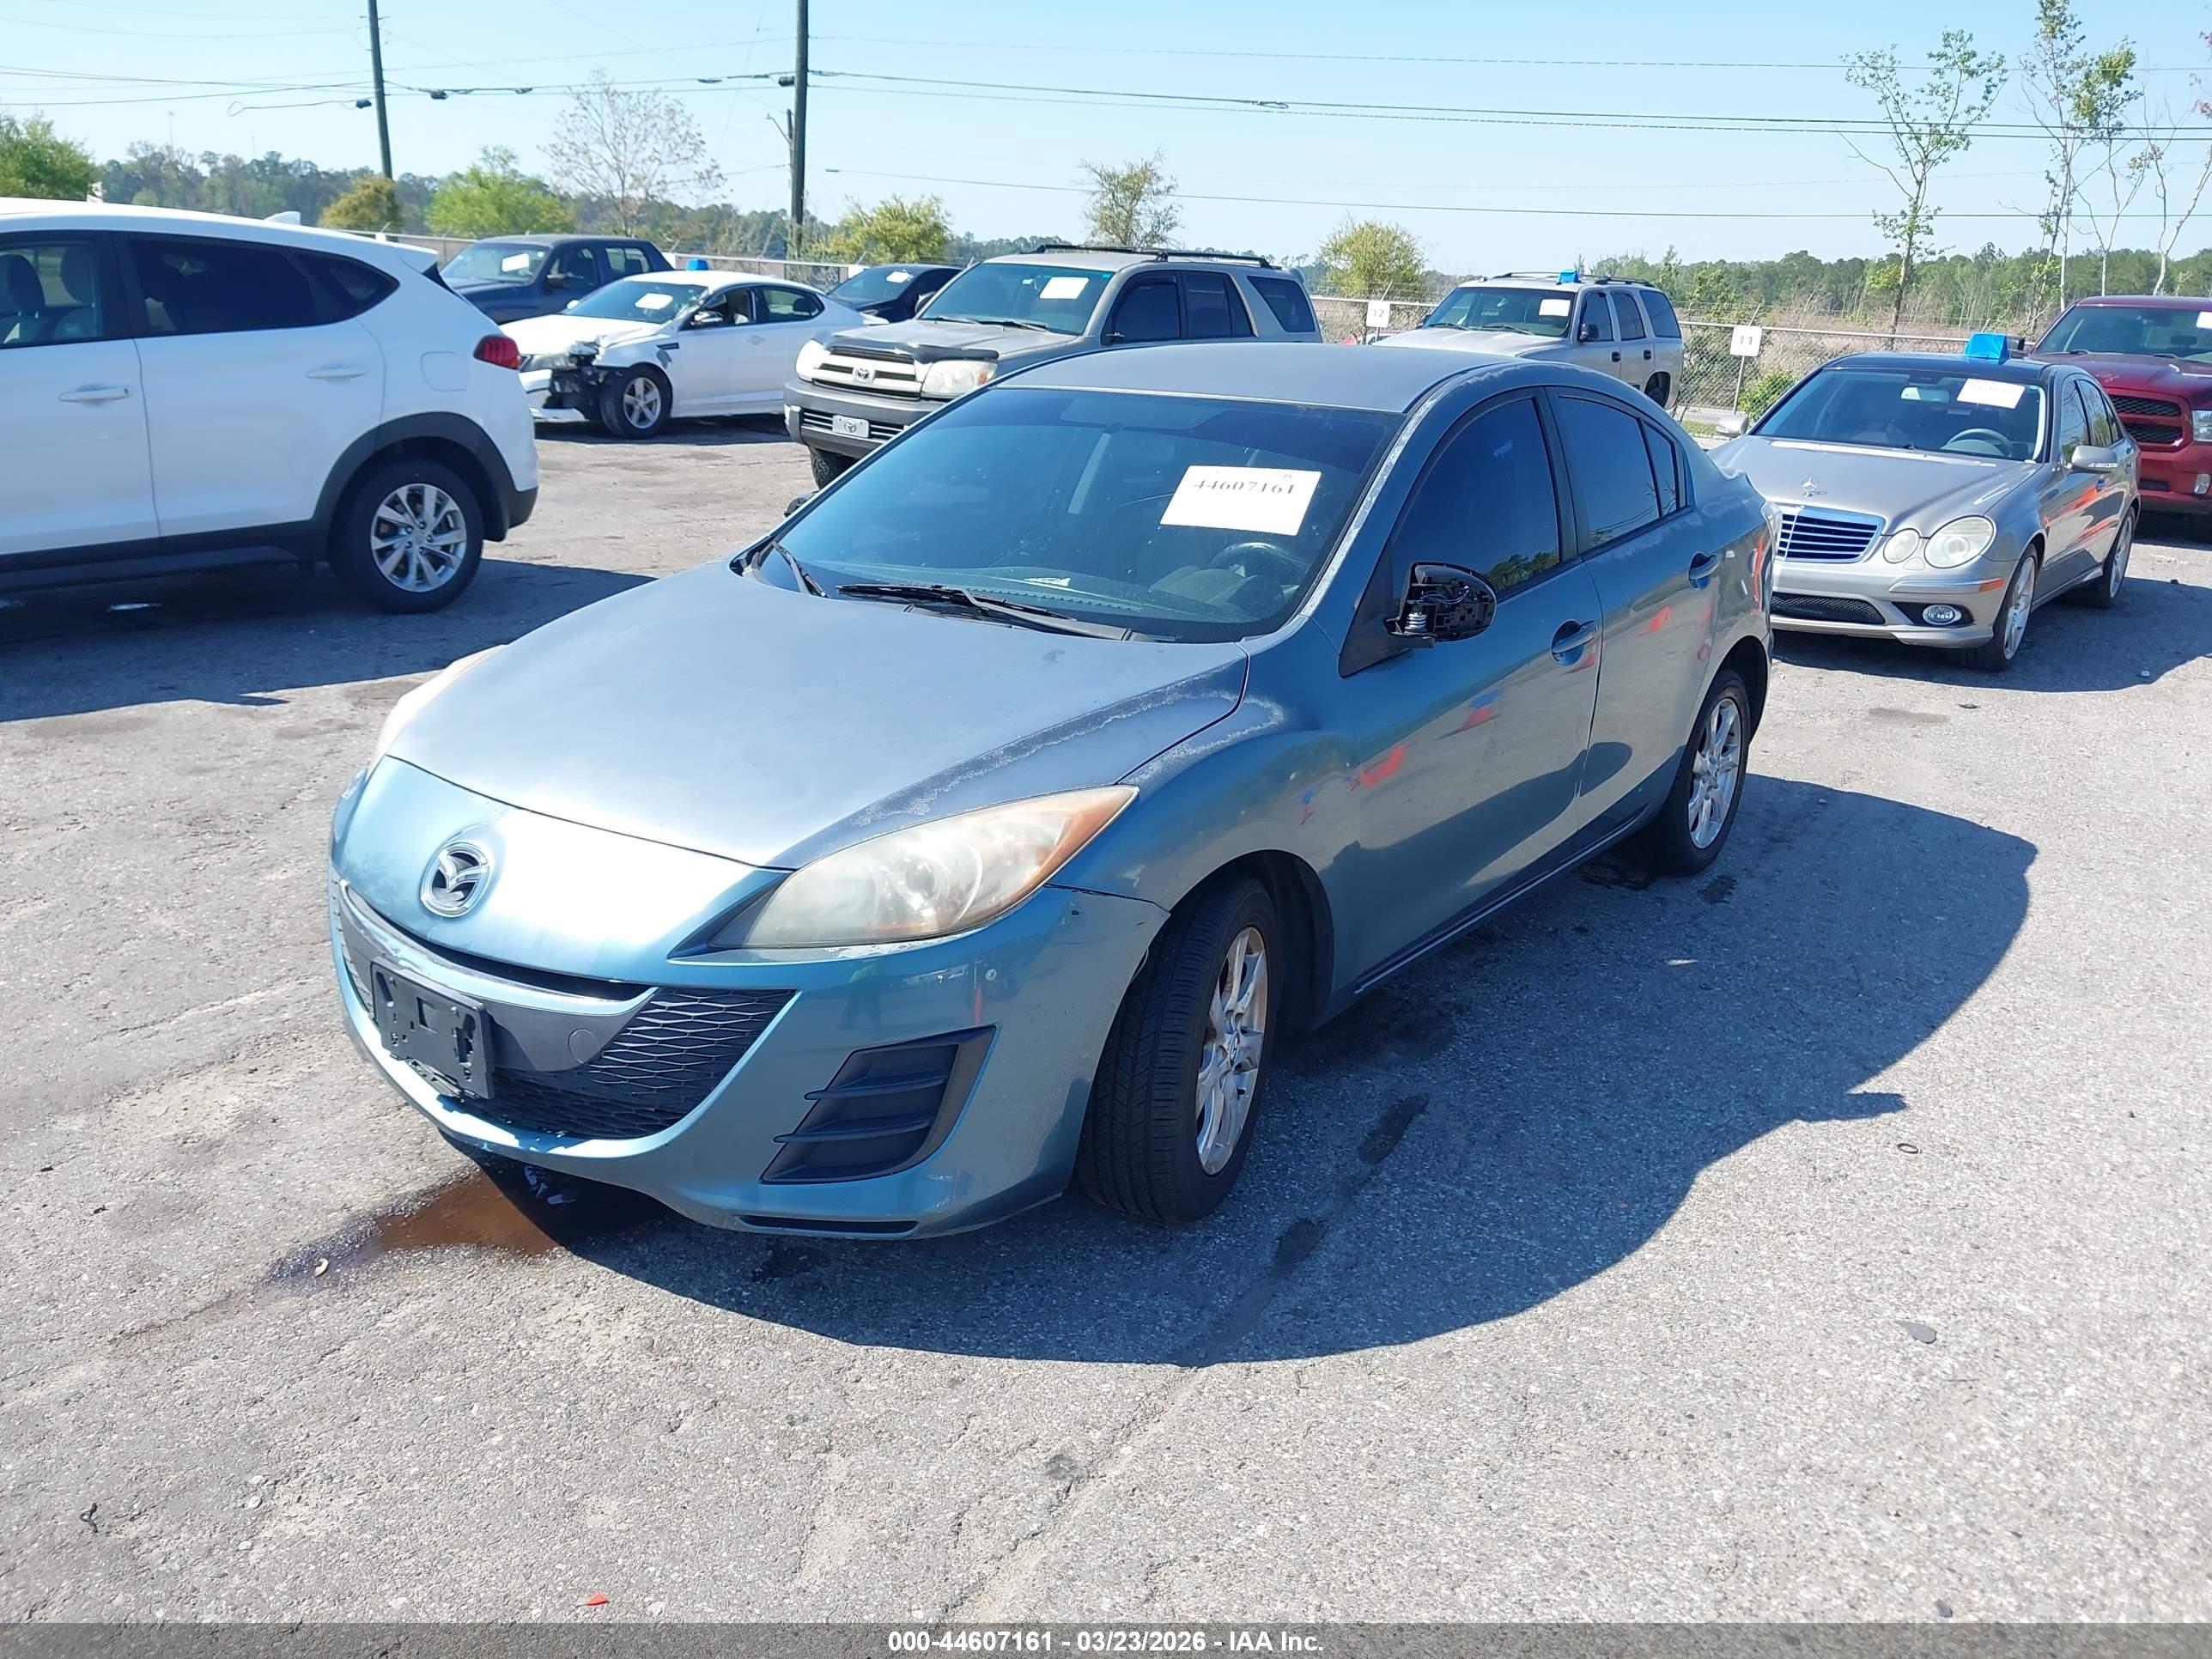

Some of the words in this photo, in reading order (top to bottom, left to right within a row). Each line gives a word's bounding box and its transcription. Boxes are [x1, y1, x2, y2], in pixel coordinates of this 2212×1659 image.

[1374, 308, 1384, 318] 12
[1740, 336, 1753, 345] 11
[1194, 479, 1295, 495] 44607161
